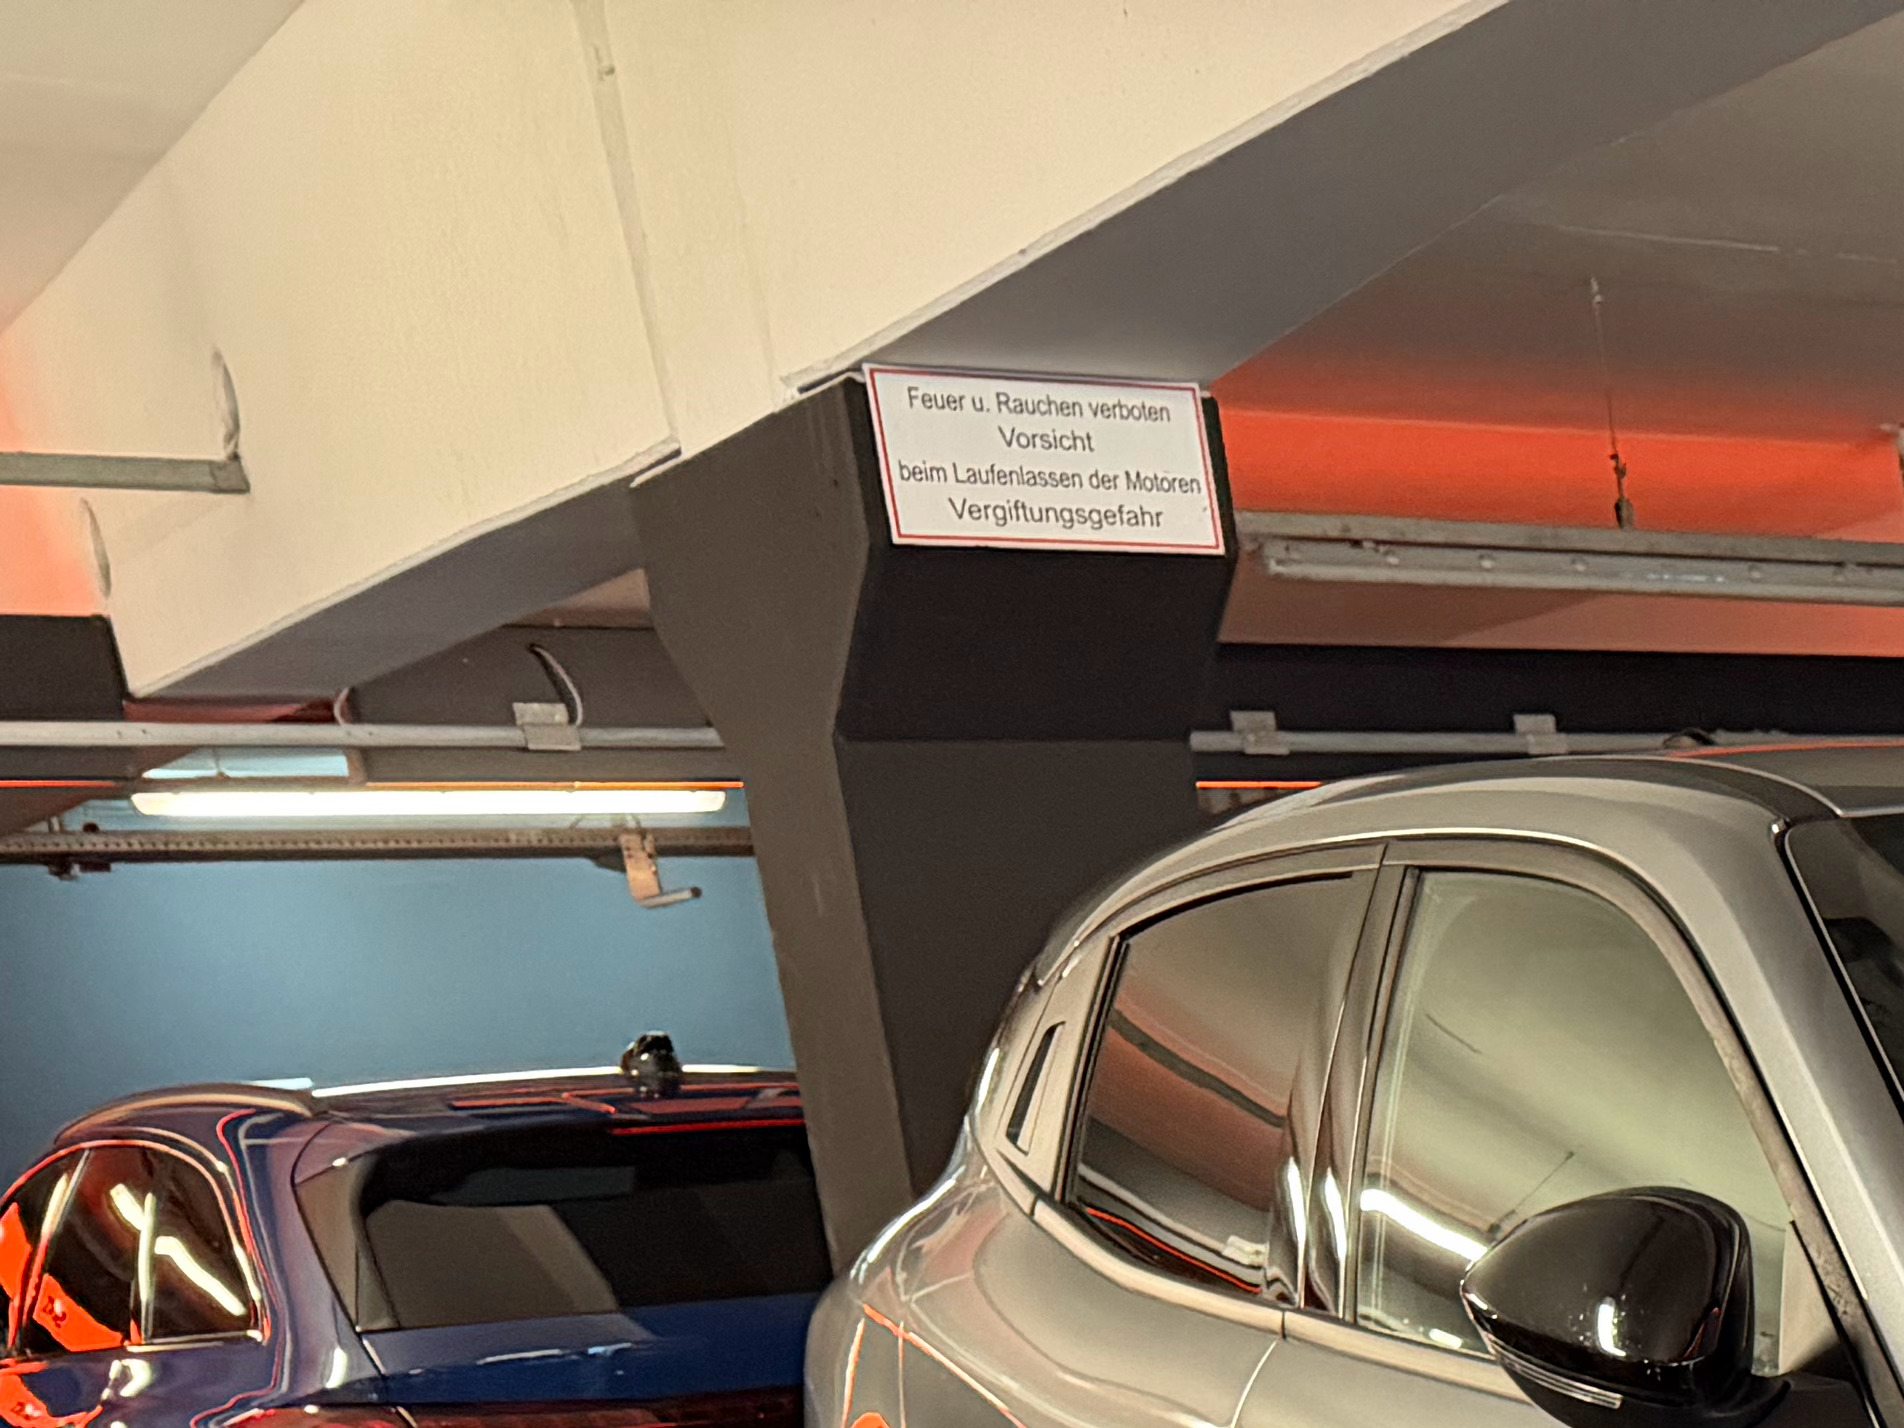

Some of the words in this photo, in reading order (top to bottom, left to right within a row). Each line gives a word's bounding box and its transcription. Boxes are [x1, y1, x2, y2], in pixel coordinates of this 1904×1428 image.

[907, 386, 966, 412] Feuer
[971, 397, 990, 413] u.
[995, 391, 1083, 418] Rauchen
[1088, 400, 1171, 423] verboten
[998, 426, 1095, 452] Vorsicht
[898, 459, 948, 484] beim
[952, 462, 1083, 490] Laufenlassen
[1088, 469, 1119, 491] der
[1124, 470, 1202, 494] Motoren
[948, 497, 1163, 530] Vergiftungsgefahr
